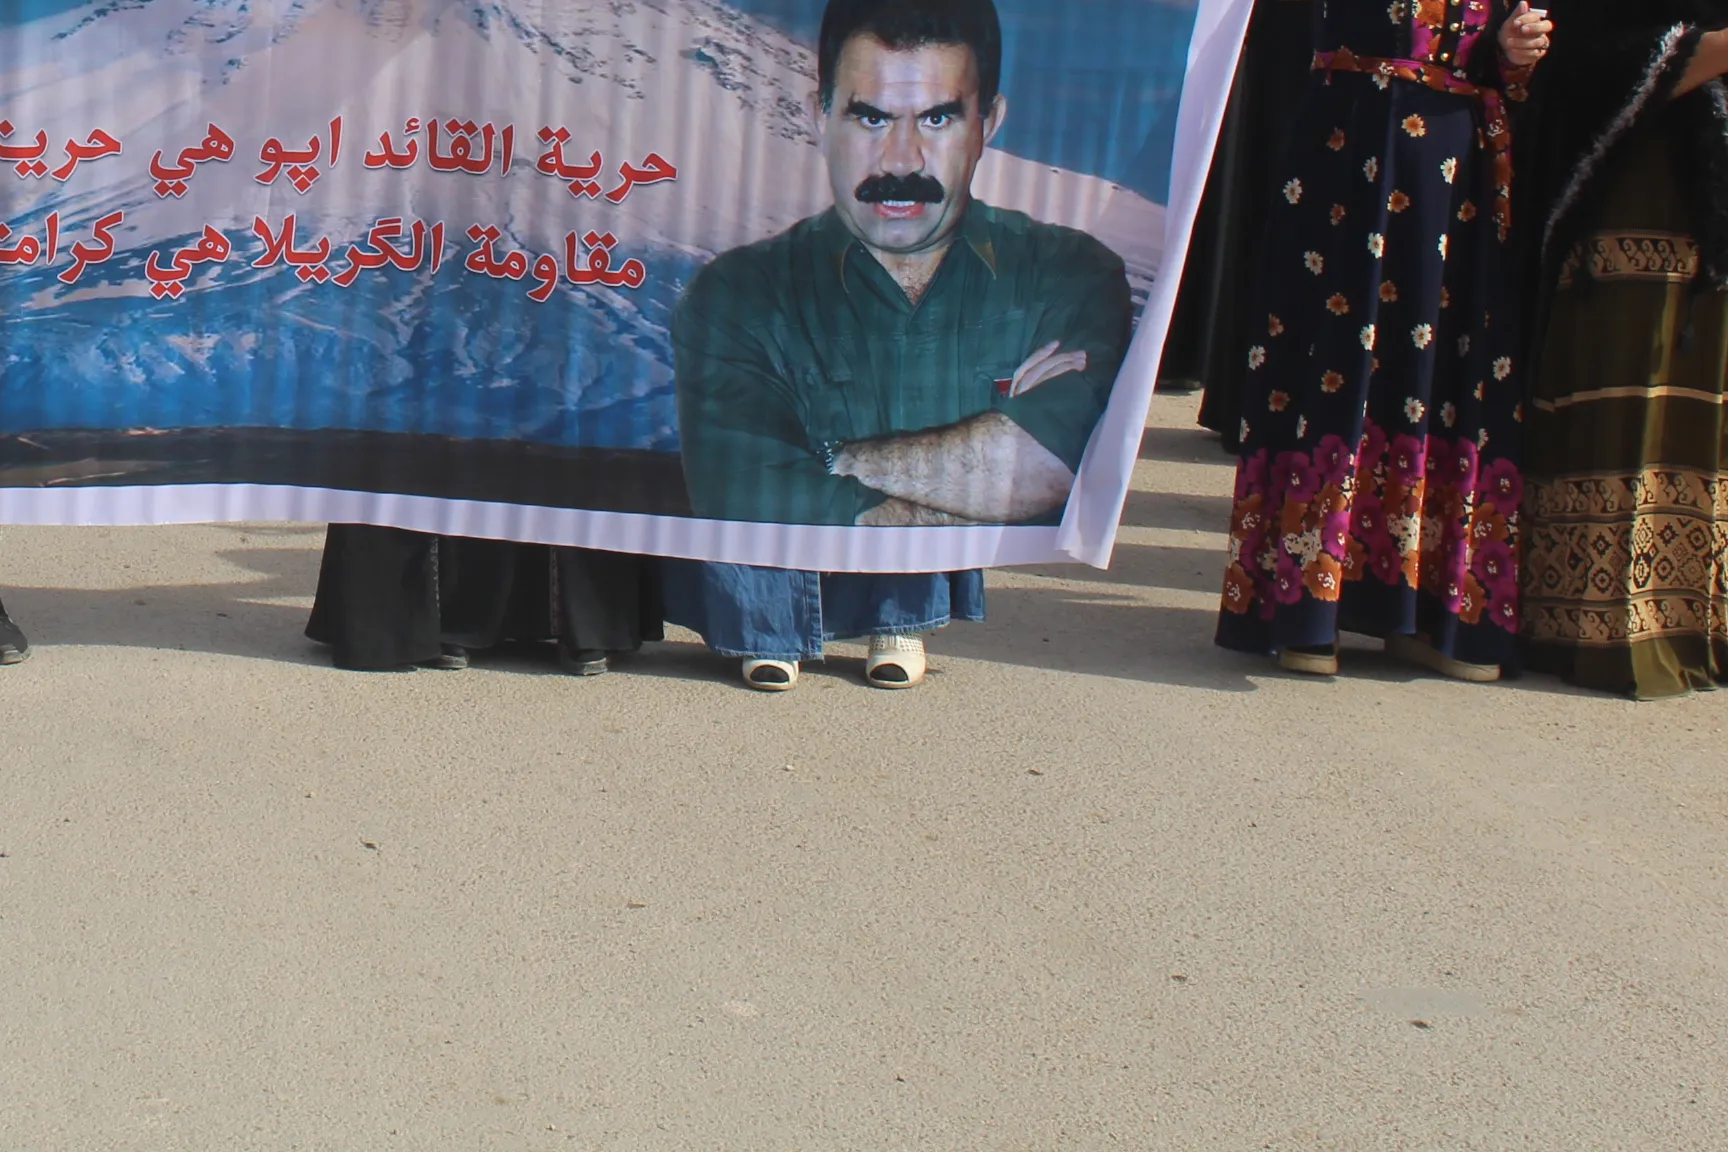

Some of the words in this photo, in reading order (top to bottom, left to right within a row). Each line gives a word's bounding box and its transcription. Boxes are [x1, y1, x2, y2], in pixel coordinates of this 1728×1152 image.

[151, 124, 235, 196] هي
[364, 117, 514, 173] القائد
[538, 126, 678, 202] حرية
[146, 225, 231, 298] هي
[466, 225, 645, 300] مقاومة
